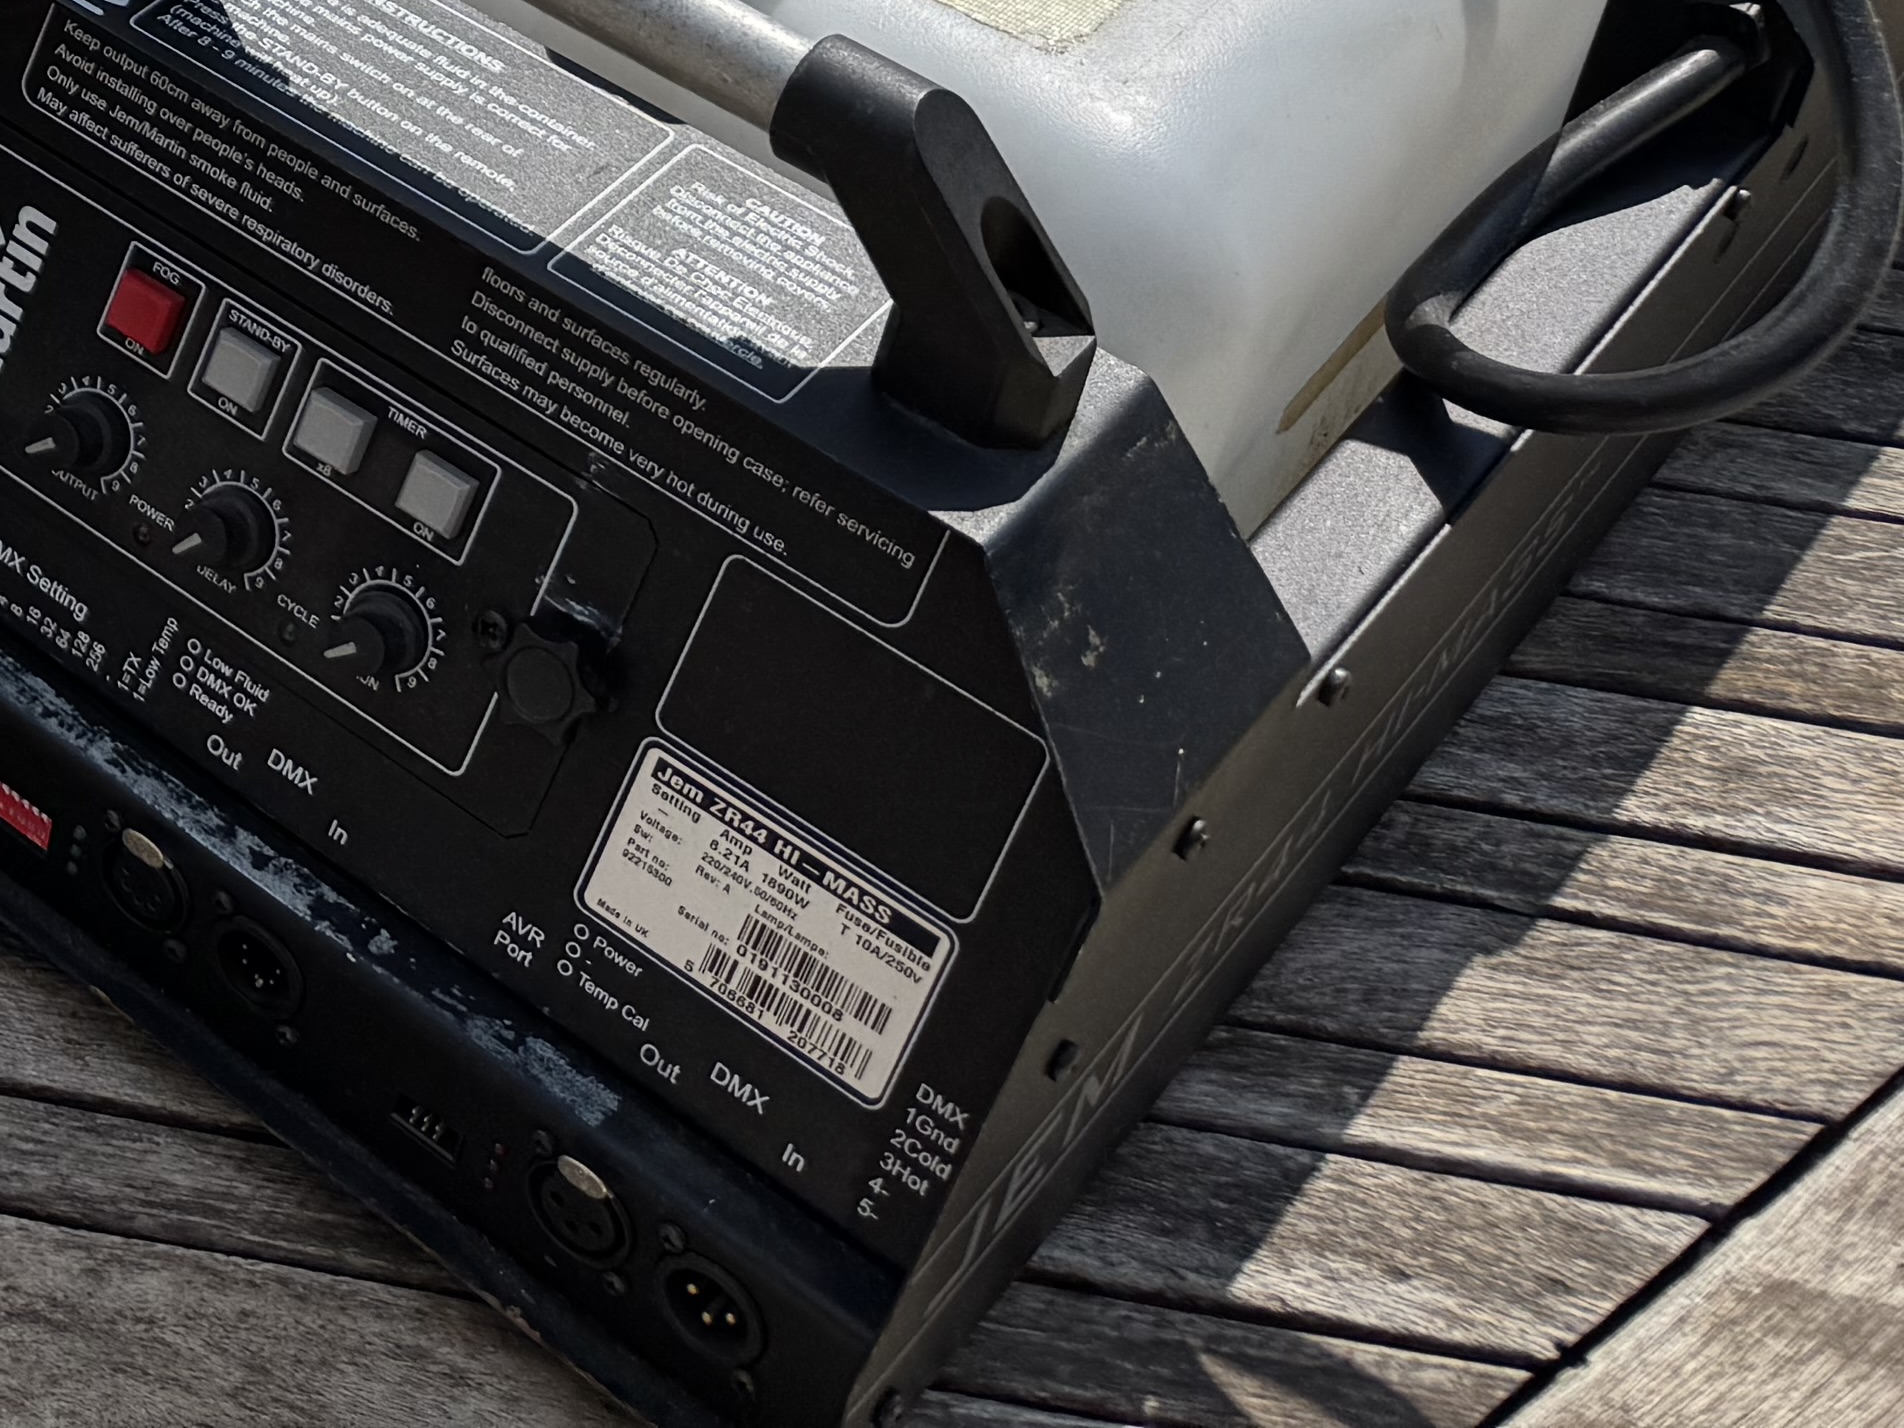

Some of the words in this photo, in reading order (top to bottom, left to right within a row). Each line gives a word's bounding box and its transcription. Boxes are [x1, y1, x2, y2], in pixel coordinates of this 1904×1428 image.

[46, 65, 79, 95] Only
[80, 88, 107, 111] use
[108, 104, 187, 159] Jem/Martin
[188, 154, 237, 189] smoke
[239, 181, 272, 212] fluid.
[54, 43, 95, 75] Avoid
[95, 70, 157, 115] installing
[159, 107, 193, 132] over
[192, 127, 254, 171] people's
[256, 162, 304, 202] heads.
[63, 19, 101, 51] Keep
[103, 45, 148, 79] output
[149, 70, 189, 103] 60cm
[190, 98, 230, 128] away
[232, 119, 266, 149] from
[266, 143, 318, 179] people
[320, 174, 352, 199] and
[352, 193, 420, 241] surfaces.
[37, 86, 67, 116] May
[68, 109, 108, 140] affect
[109, 134, 171, 178] sufferers
[173, 173, 191, 188] of
[189, 183, 239, 220] severe
[241, 214, 320, 270] respiratory
[321, 263, 393, 315] disorders.
[152, 261, 180, 285] FOG
[228, 309, 291, 352] STAND-BY
[481, 266, 526, 302] floors
[527, 297, 561, 322] and
[561, 317, 629, 365] surfaces
[633, 359, 706, 410] regularly.
[461, 315, 477, 334] to
[480, 329, 548, 376] qualified
[546, 370, 629, 428] personnel.
[388, 406, 427, 439] TIMER
[471, 290, 559, 353] Disconnect
[560, 347, 615, 387] supply
[616, 377, 669, 419] before
[672, 415, 740, 464] opening
[742, 456, 789, 492] case;
[792, 486, 835, 516] refer
[836, 512, 915, 569] servicing
[450, 339, 520, 391] Surfaces
[522, 385, 558, 414] may
[559, 405, 624, 454] become
[629, 448, 665, 479] very
[666, 470, 695, 497] hot
[696, 492, 750, 534] during
[753, 526, 787, 556] use.
[129, 494, 174, 531] POWER
[26, 564, 88, 621] Setting
[277, 594, 320, 629] CYCLE
[117, 651, 141, 690] 1=TX
[132, 656, 160, 701] 1=Low
[151, 617, 178, 654] Temp
[204, 648, 233, 676] Low
[234, 670, 270, 702] Fluid
[189, 683, 233, 724] Ready
[196, 666, 232, 698] DMX
[233, 692, 257, 717] OK
[206, 734, 242, 770] Out
[267, 748, 318, 795] DMX
[651, 782, 701, 824] Setting
[328, 819, 348, 845] In
[657, 767, 704, 803] Jem
[709, 797, 767, 843] ZR44
[773, 839, 800, 865] HI
[822, 870, 891, 924] MASS
[714, 829, 753, 856] Amp
[709, 839, 749, 872] 8.21A
[762, 873, 810, 909] 1890W
[778, 864, 811, 894] Watt
[493, 929, 533, 967] Port
[502, 911, 545, 948] AVR
[677, 905, 709, 932] Serial
[711, 929, 729, 945] no:
[835, 903, 931, 972] Fuse/Fusible
[593, 936, 643, 977] Power
[840, 922, 850, 935] T
[855, 934, 922, 984] 10A/250V
[579, 971, 618, 1009] Temp
[621, 1004, 650, 1031] Cal
[709, 975, 764, 1020] 706681
[736, 944, 843, 1021] 0191130008
[639, 1043, 680, 1084] Out
[786, 1029, 845, 1075] 207718
[922, 1012, 1146, 1319] JEM
[1172, 789, 1333, 1007] ZR44
[710, 1061, 770, 1114] DMX
[915, 1082, 969, 1129] DMX
[906, 1107, 959, 1154] 1Gnd
[782, 1143, 804, 1172] In
[879, 1151, 928, 1196] 3Hot
[889, 1128, 952, 1180] 2Cold
